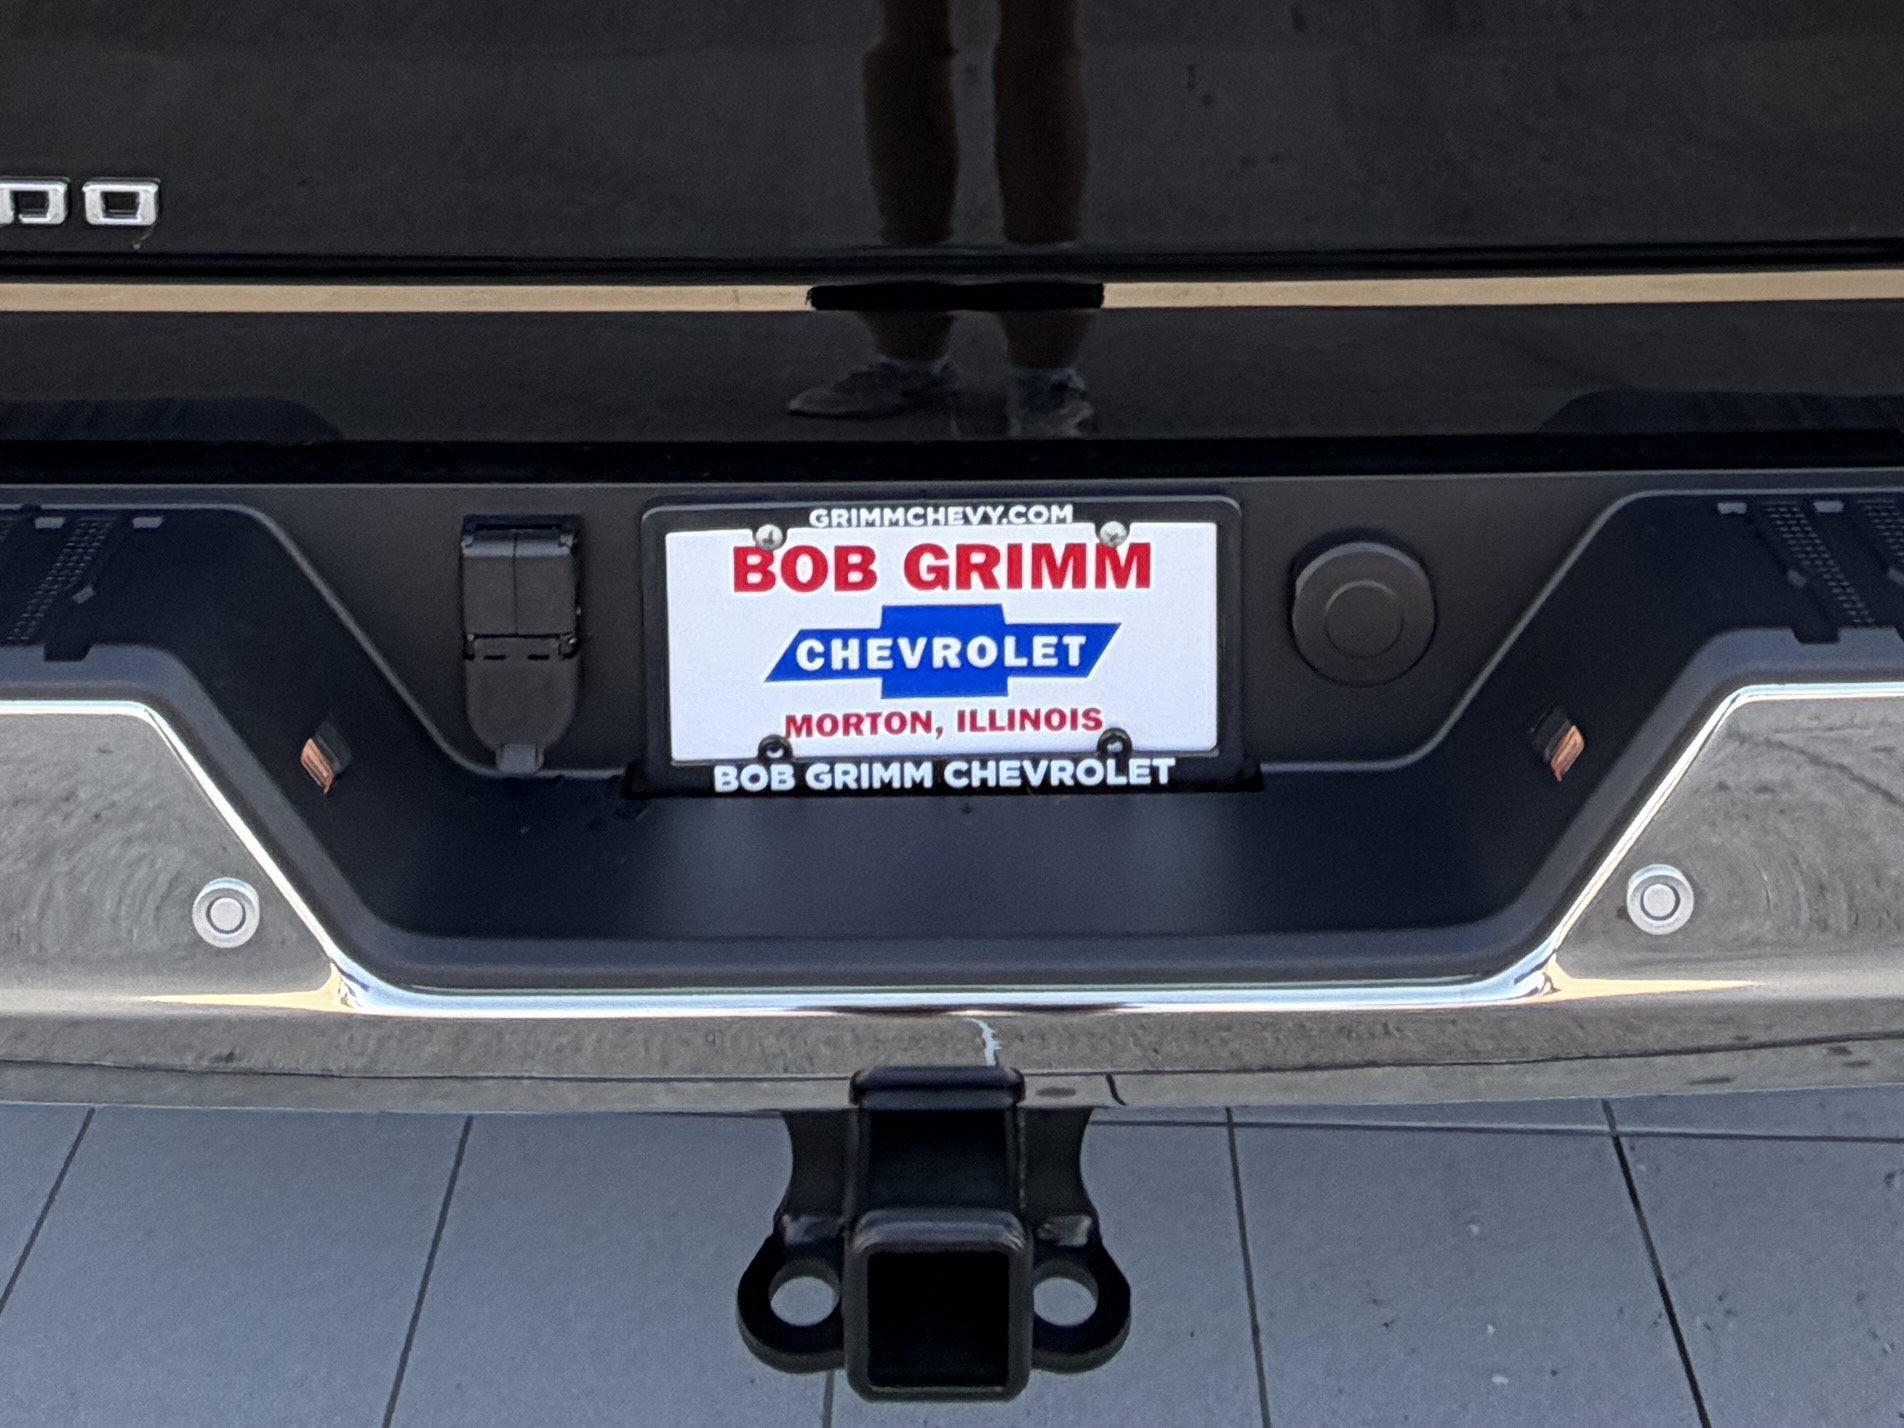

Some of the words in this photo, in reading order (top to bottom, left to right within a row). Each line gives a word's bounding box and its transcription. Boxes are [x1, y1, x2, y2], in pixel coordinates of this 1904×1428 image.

[809, 504, 1074, 529] GRIMMCHEVY.COM
[733, 544, 878, 593] BOB
[903, 541, 1152, 592] GRIMM
[795, 634, 1087, 671] CHEVROLET
[784, 710, 944, 741] MORTON,
[956, 706, 1104, 733] ILLINOIS
[713, 762, 795, 793] BOB
[805, 759, 934, 791] GRIMM
[944, 757, 1177, 788] CHEVROLET
